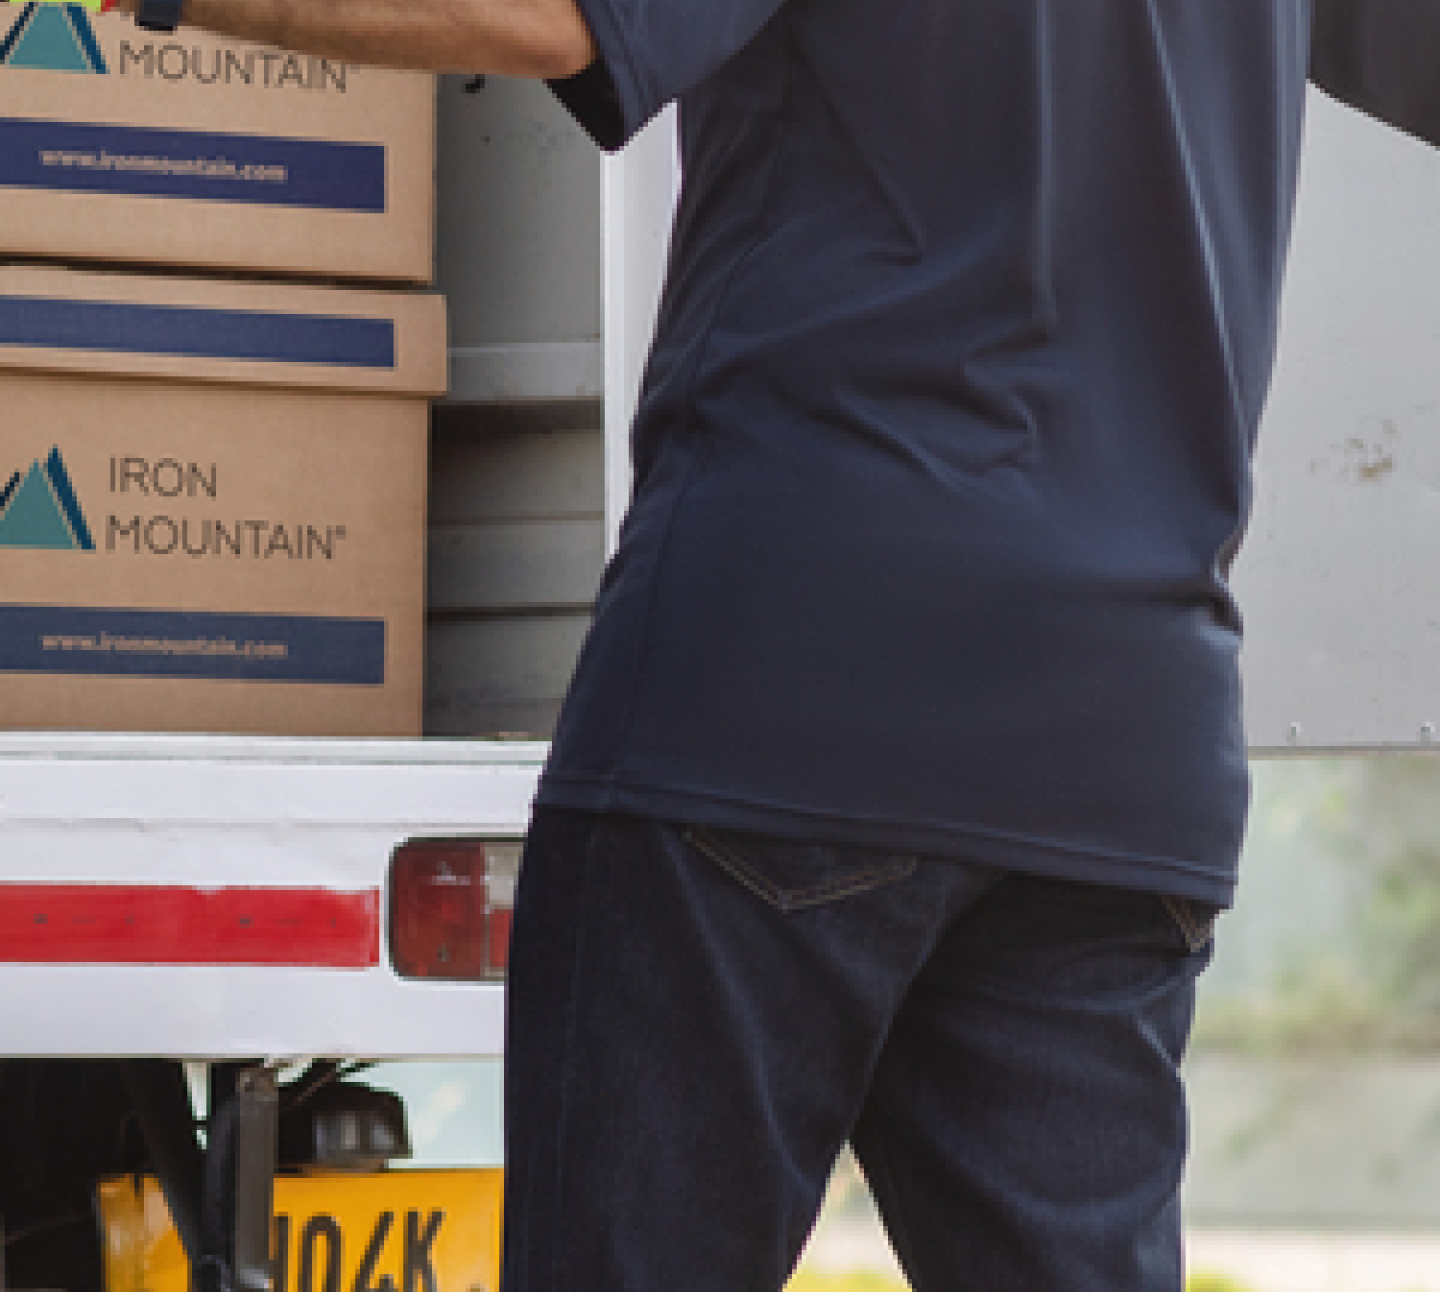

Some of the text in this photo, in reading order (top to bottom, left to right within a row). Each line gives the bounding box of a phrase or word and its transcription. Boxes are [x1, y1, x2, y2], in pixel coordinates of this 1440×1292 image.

[38, 149, 289, 185] www.ironmountain.com
[109, 454, 217, 501] IRON
[38, 630, 289, 660] www.ironmountain.com
